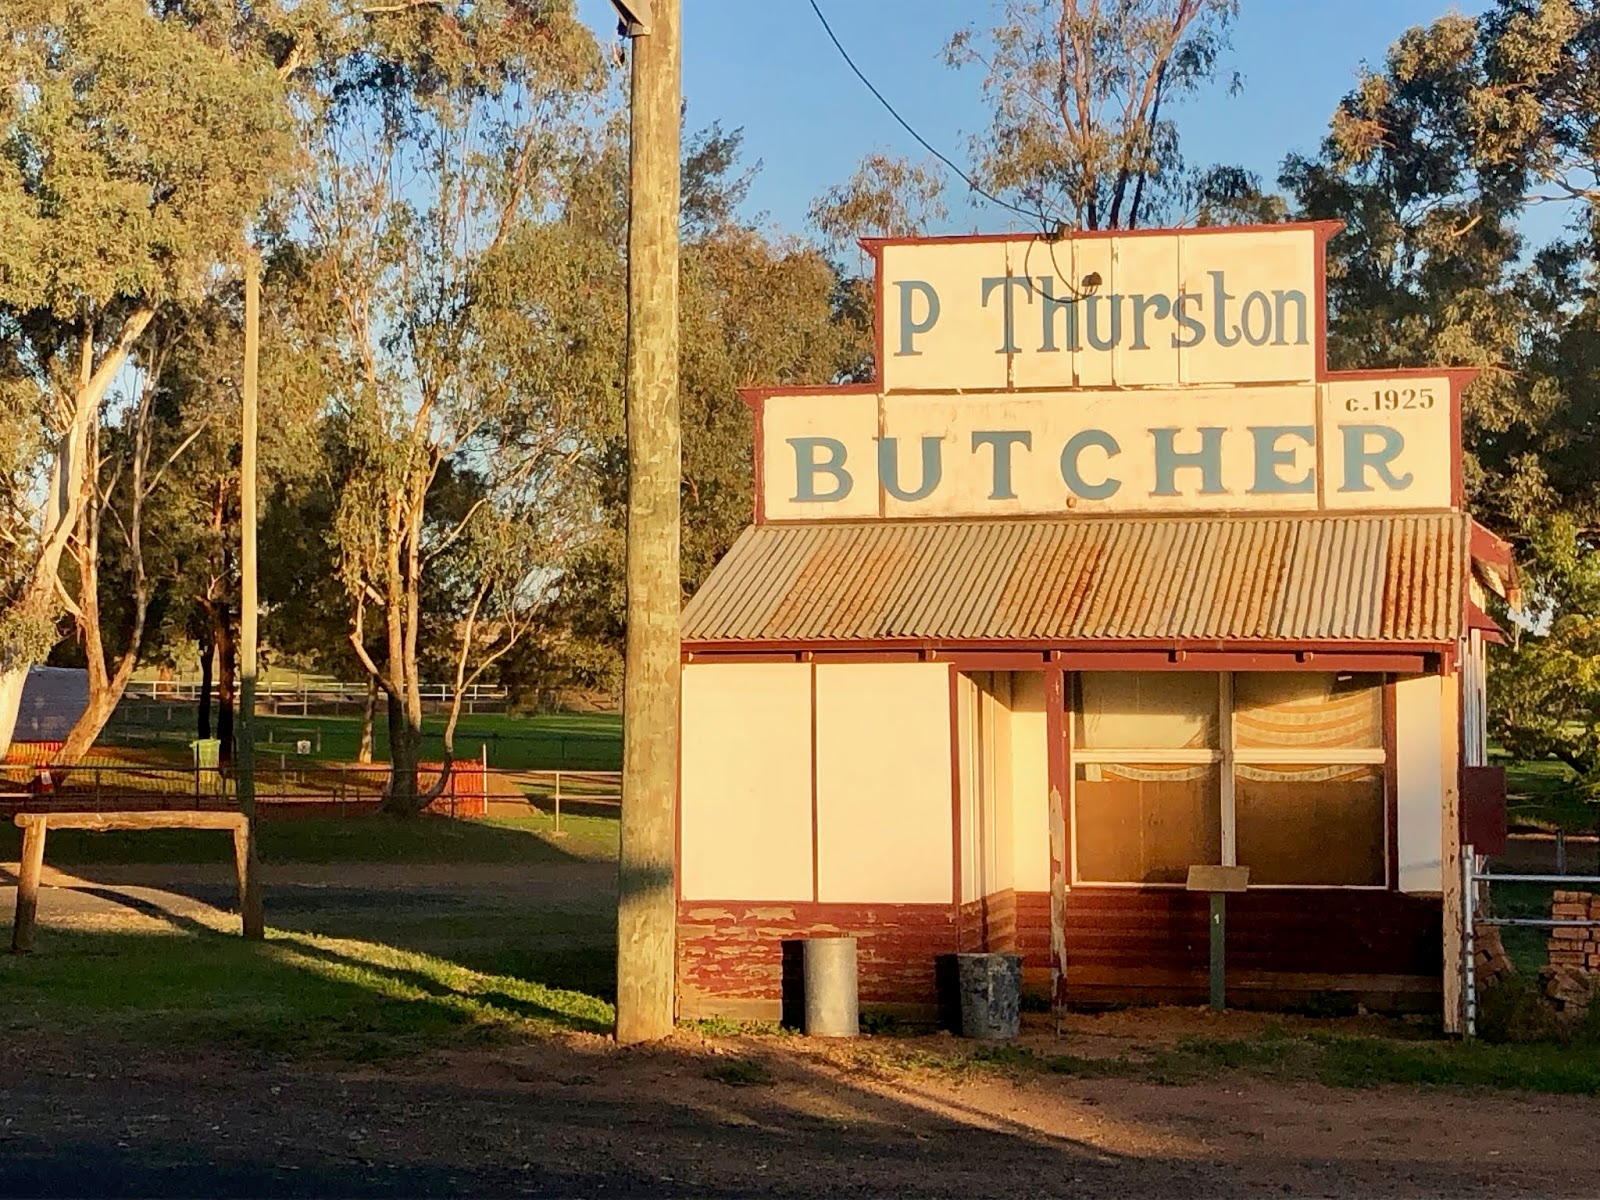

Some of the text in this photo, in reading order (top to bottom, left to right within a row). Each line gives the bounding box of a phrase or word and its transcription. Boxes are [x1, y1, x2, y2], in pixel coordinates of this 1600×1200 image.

[892, 270, 1310, 357] P Thurston
[1345, 388, 1435, 412] c.1925
[785, 424, 1414, 503] BUTCHER
[1213, 913, 1220, 925] 1
